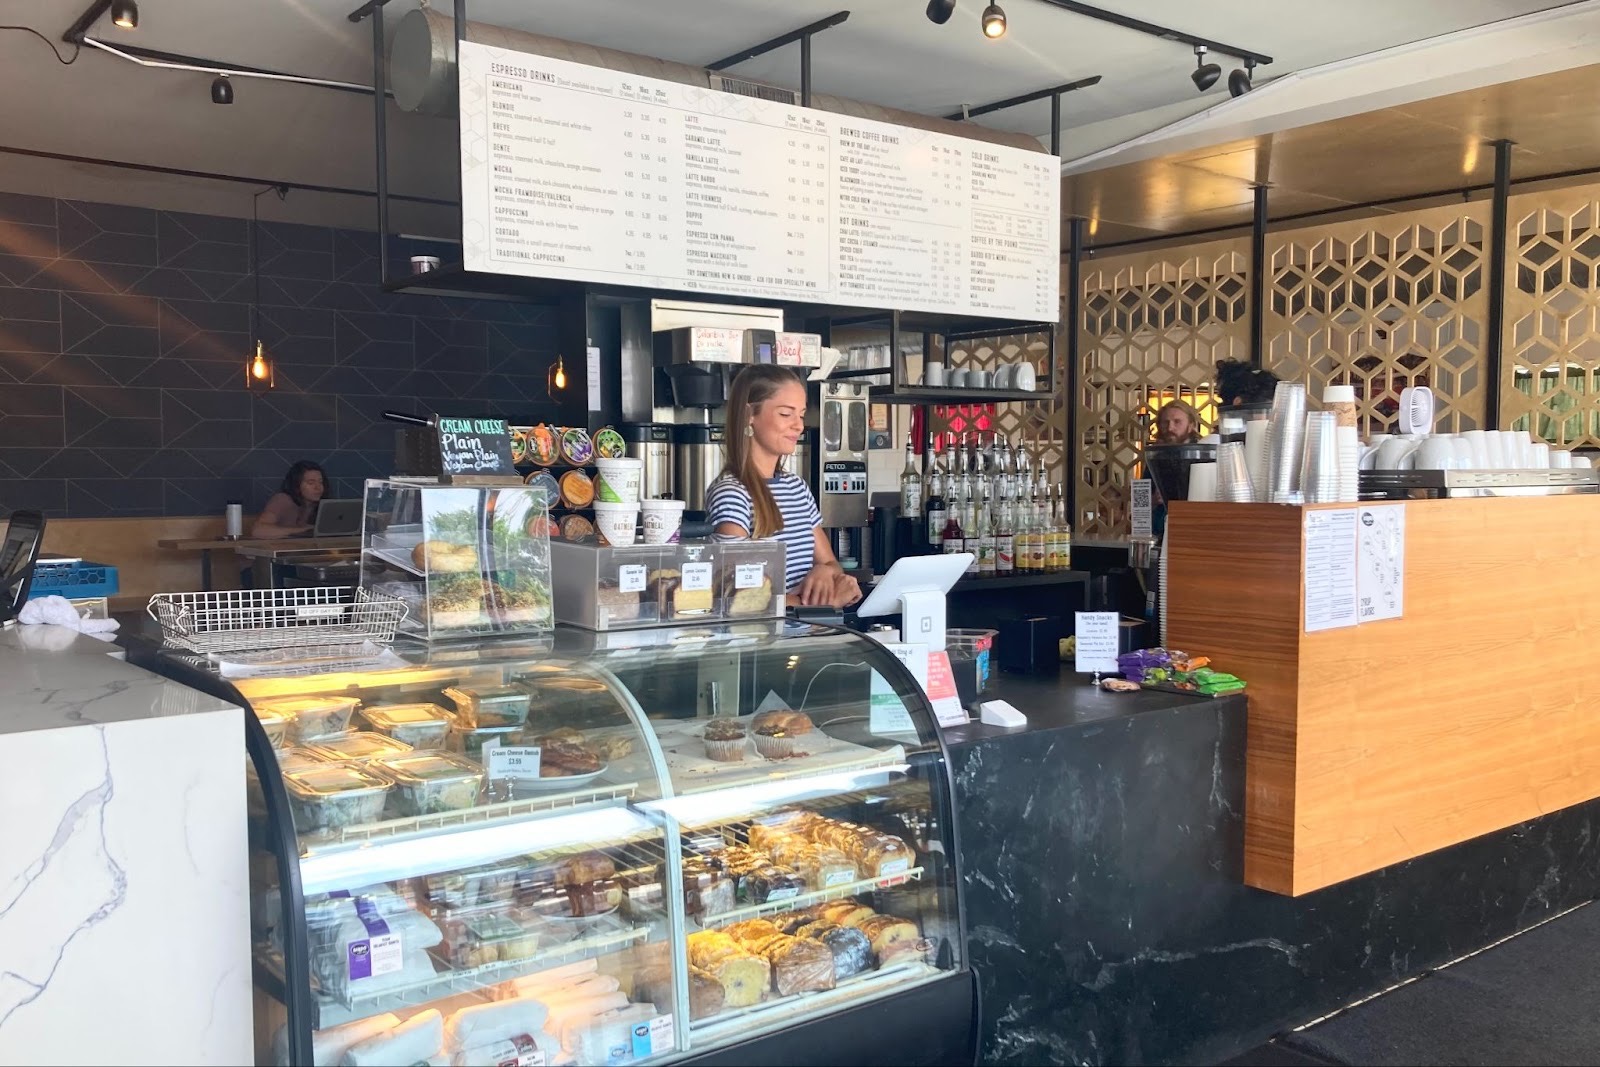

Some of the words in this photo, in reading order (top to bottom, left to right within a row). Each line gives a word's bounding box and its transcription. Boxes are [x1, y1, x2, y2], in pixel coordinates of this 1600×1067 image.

[491, 62, 526, 77] ESPRESSO
[530, 69, 555, 83] DRINKS
[440, 419, 473, 434] CREAM
[474, 419, 505, 434] CHEESE
[441, 434, 482, 450] Plain
